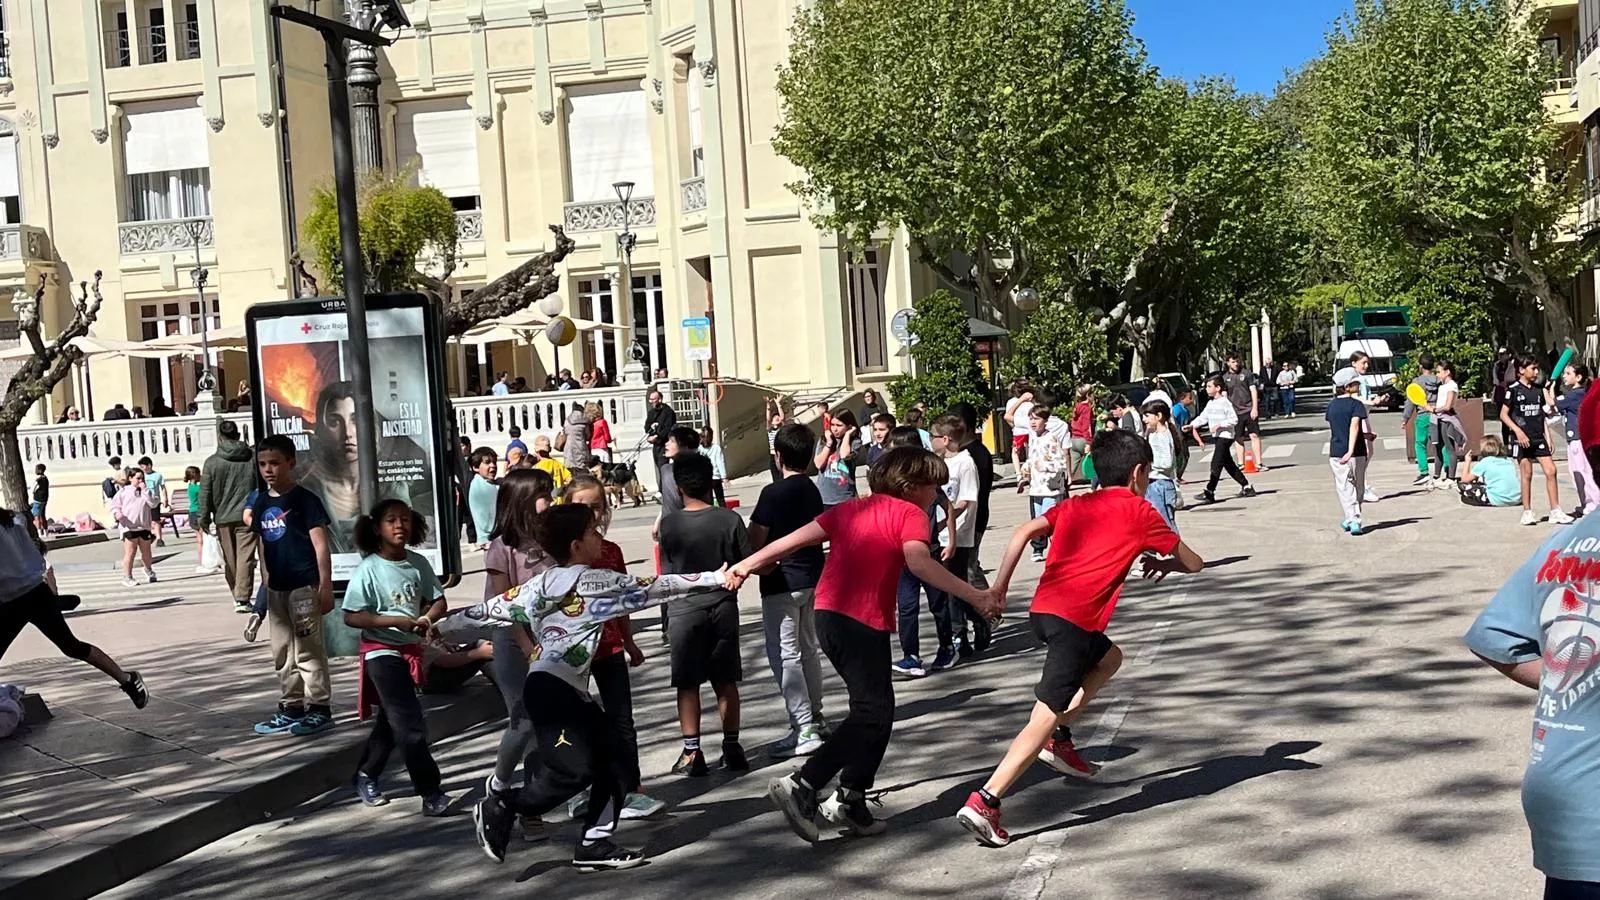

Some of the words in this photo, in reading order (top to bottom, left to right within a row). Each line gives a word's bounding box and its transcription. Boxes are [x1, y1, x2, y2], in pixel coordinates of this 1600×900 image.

[270, 402, 280, 418] EL
[400, 402, 409, 419] ES
[410, 402, 420, 418] LA
[272, 416, 303, 435] VOLCÁN
[382, 419, 422, 437] ANSIEDAD
[261, 519, 286, 529] NASA
